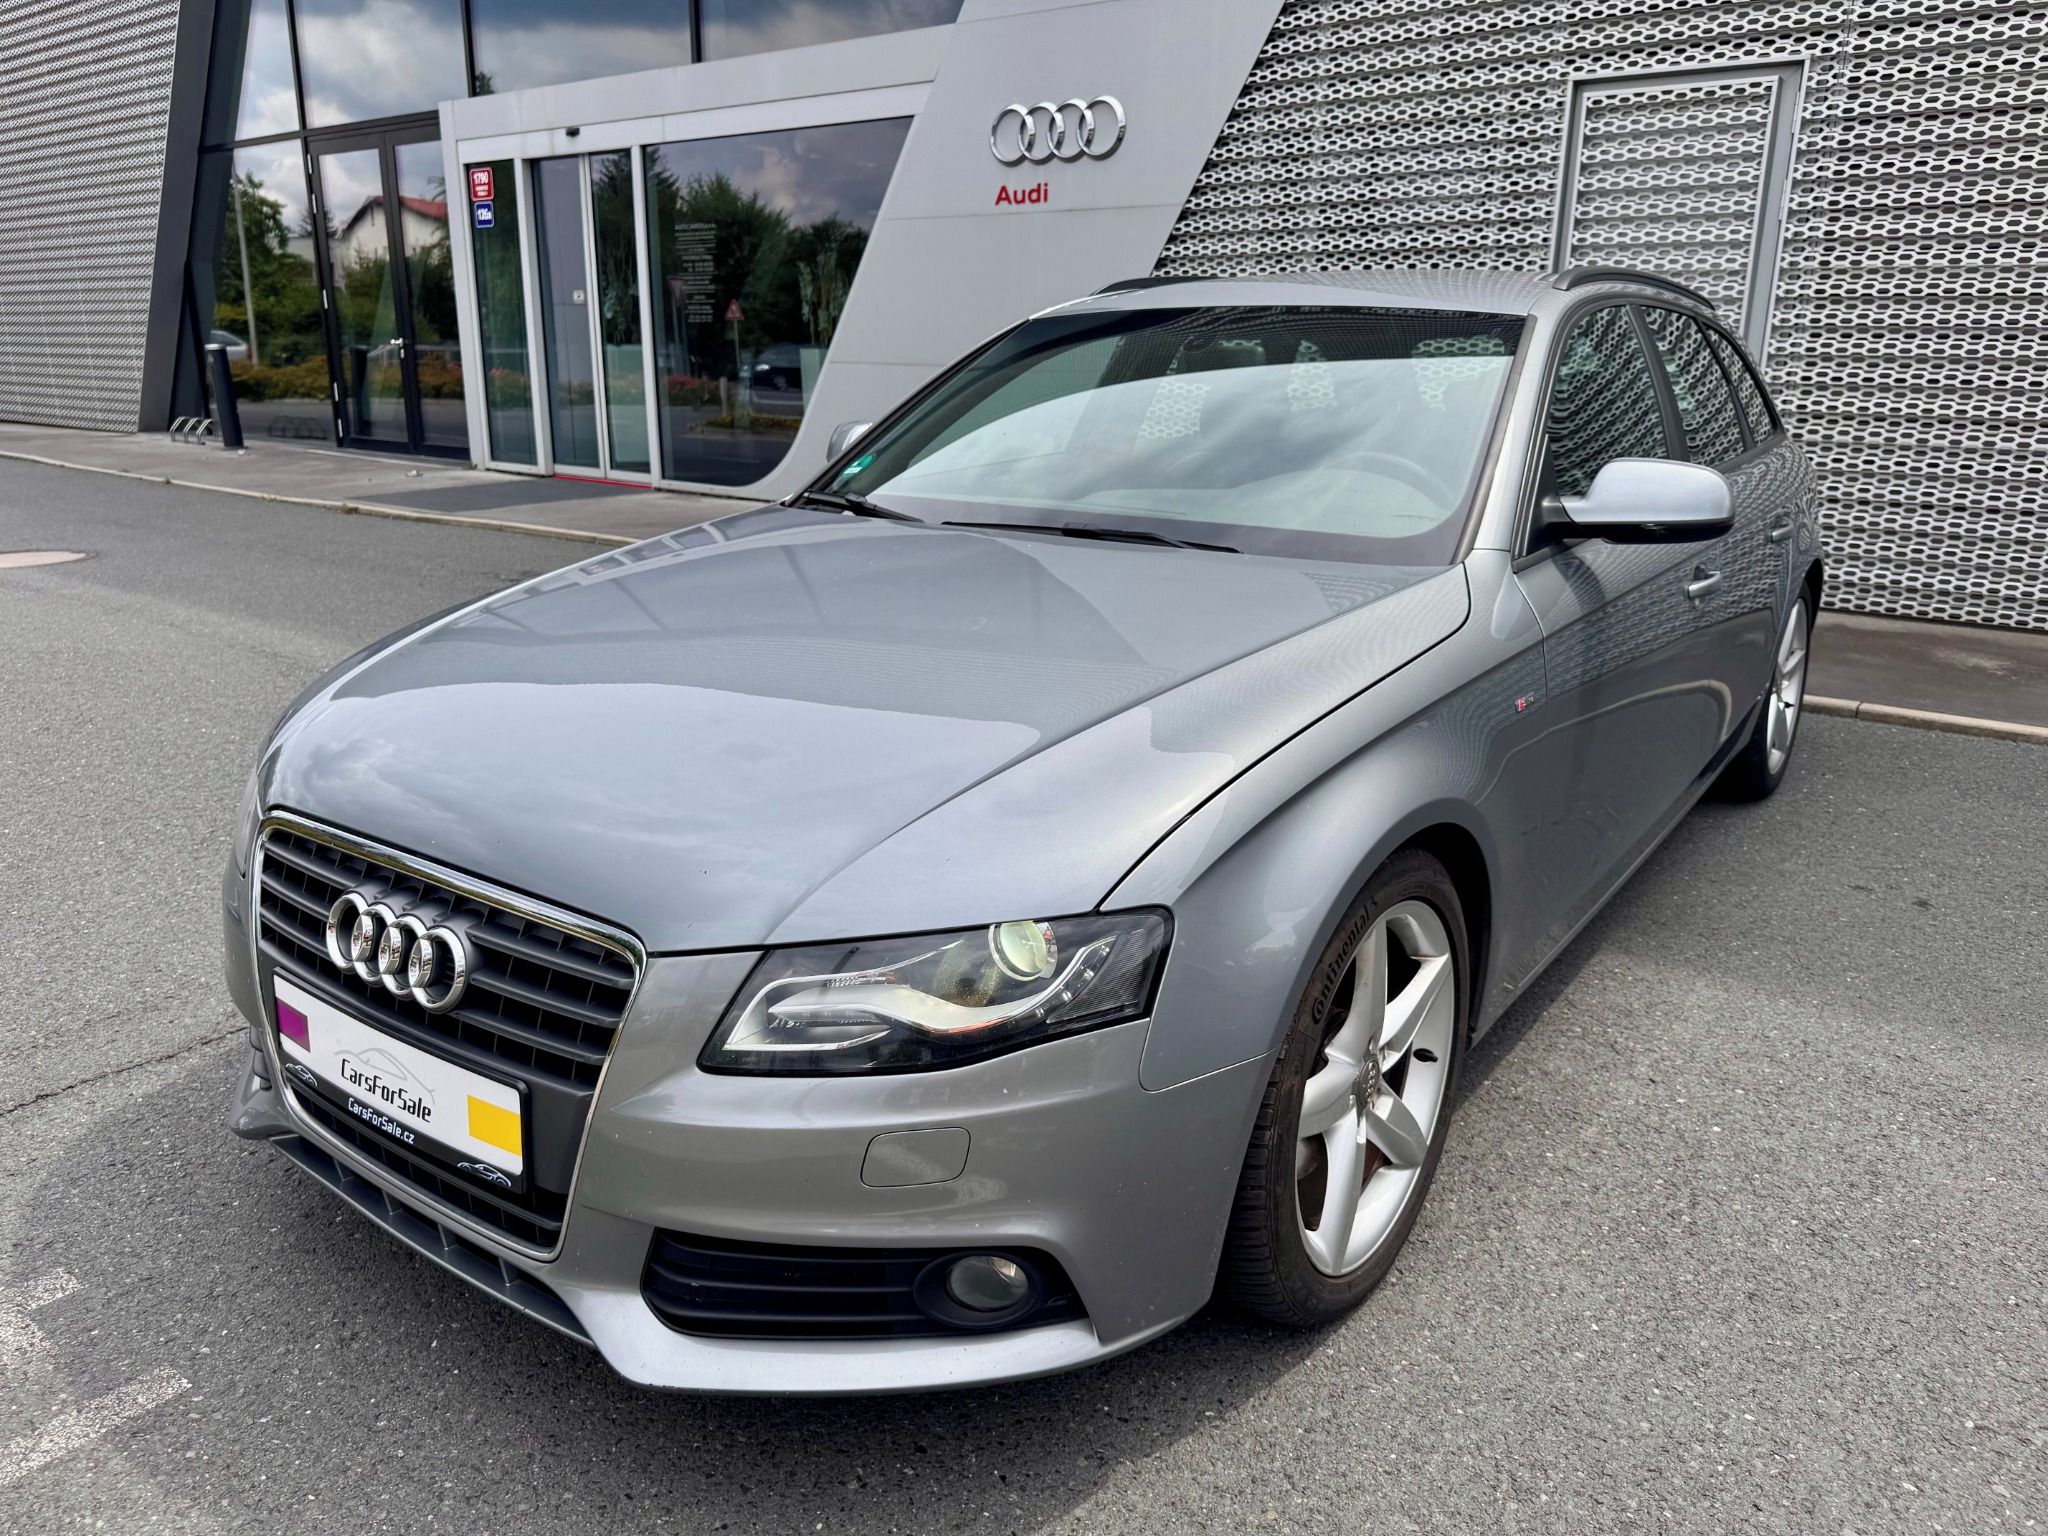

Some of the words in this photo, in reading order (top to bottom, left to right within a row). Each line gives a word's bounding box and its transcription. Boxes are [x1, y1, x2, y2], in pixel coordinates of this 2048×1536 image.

[995, 182, 1048, 205] Audi
[1312, 903, 1370, 1025] Continental
[341, 1058, 432, 1123] CarsForSale
[348, 1097, 415, 1145] CarsForSale.cz
